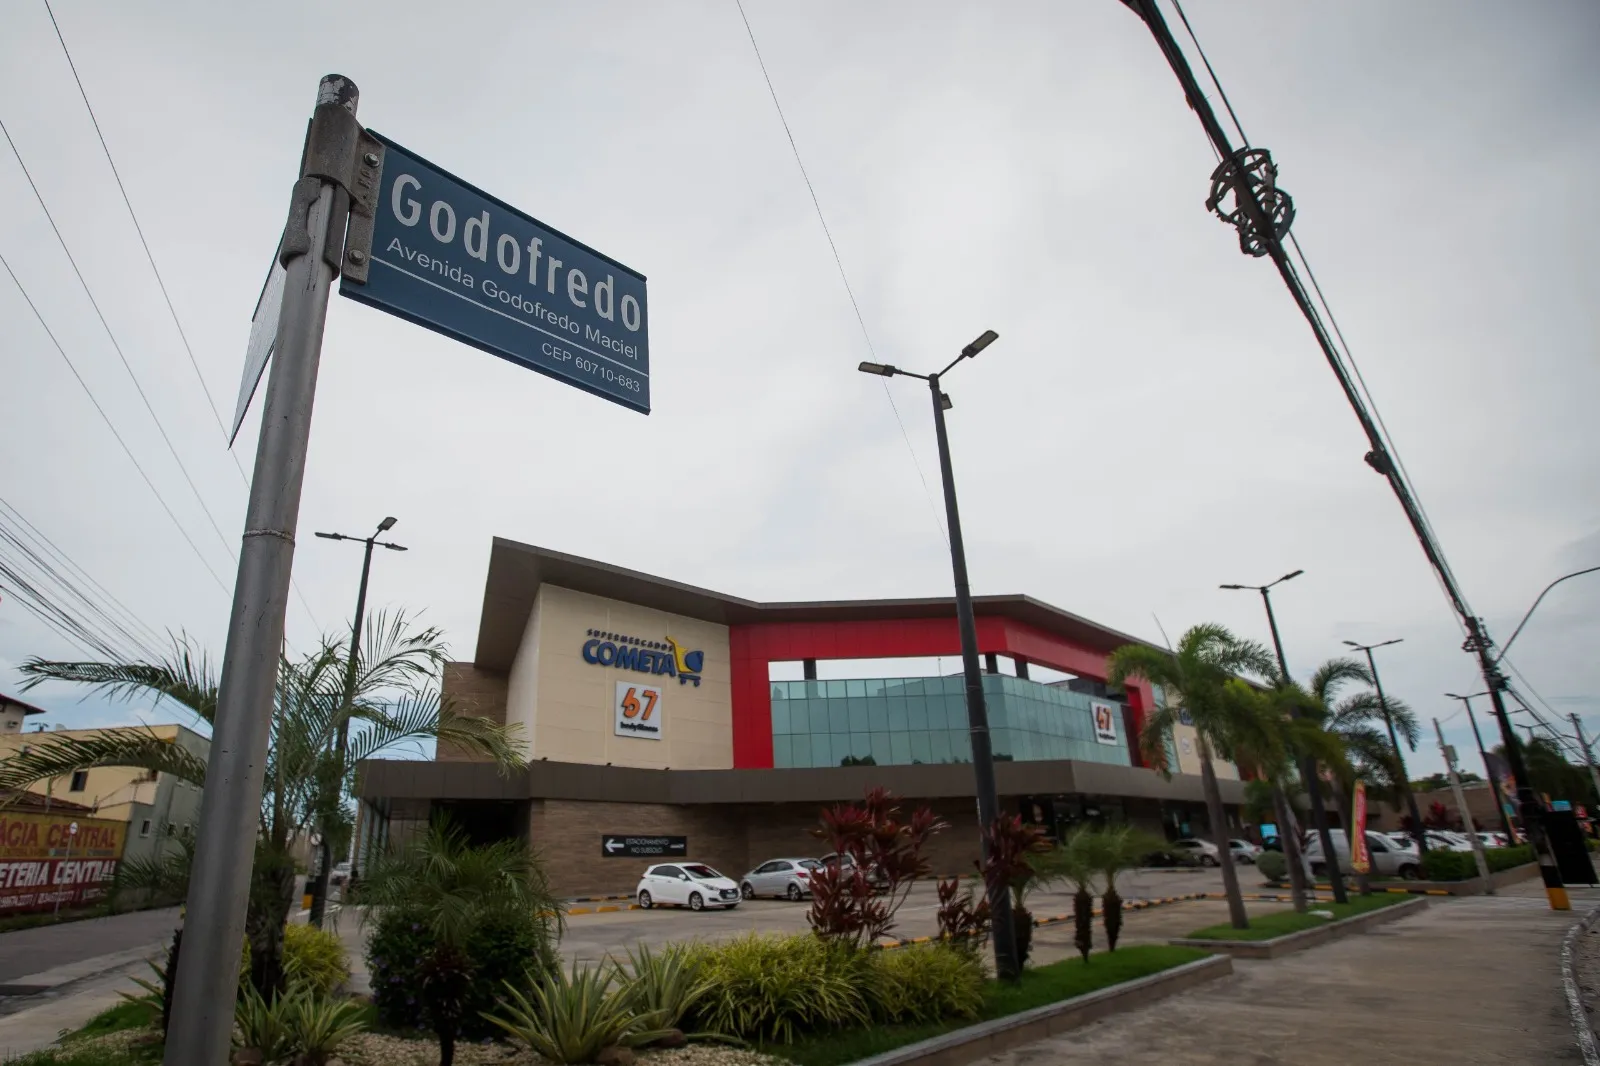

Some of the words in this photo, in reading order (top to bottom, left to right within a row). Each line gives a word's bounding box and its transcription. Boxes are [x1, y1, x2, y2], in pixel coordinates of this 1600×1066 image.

[391, 173, 641, 332] Godofredo
[386, 237, 474, 289] Avenida
[482, 279, 580, 334] Godofredo
[585, 324, 638, 360] Maciel
[541, 342, 572, 363] CEP
[575, 356, 640, 393] 60710-683
[583, 638, 676, 677] COMETA
[587, 629, 674, 651] SUPERMERCADOS
[621, 687, 658, 721] 67
[46, 823, 116, 848] CENTRAL
